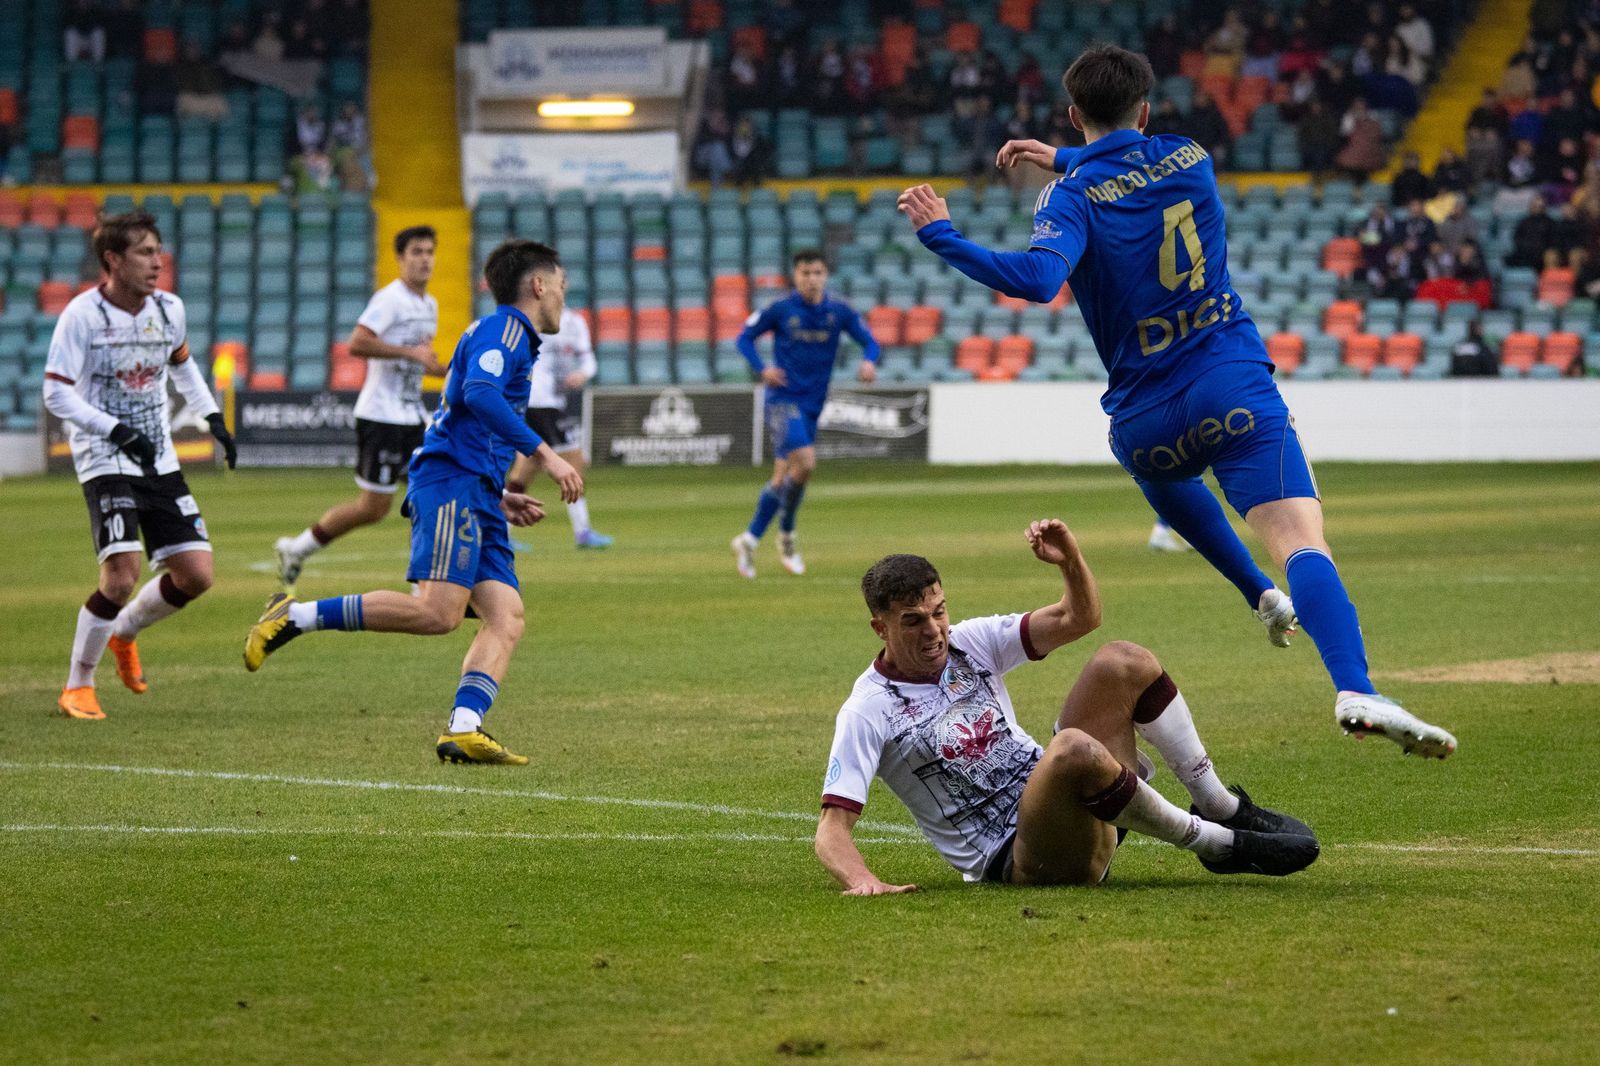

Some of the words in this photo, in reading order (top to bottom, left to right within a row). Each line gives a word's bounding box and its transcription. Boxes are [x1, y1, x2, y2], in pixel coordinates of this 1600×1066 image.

[1159, 199, 1207, 292] 4
[1136, 293, 1232, 357] DIGI
[103, 513, 125, 543] 10
